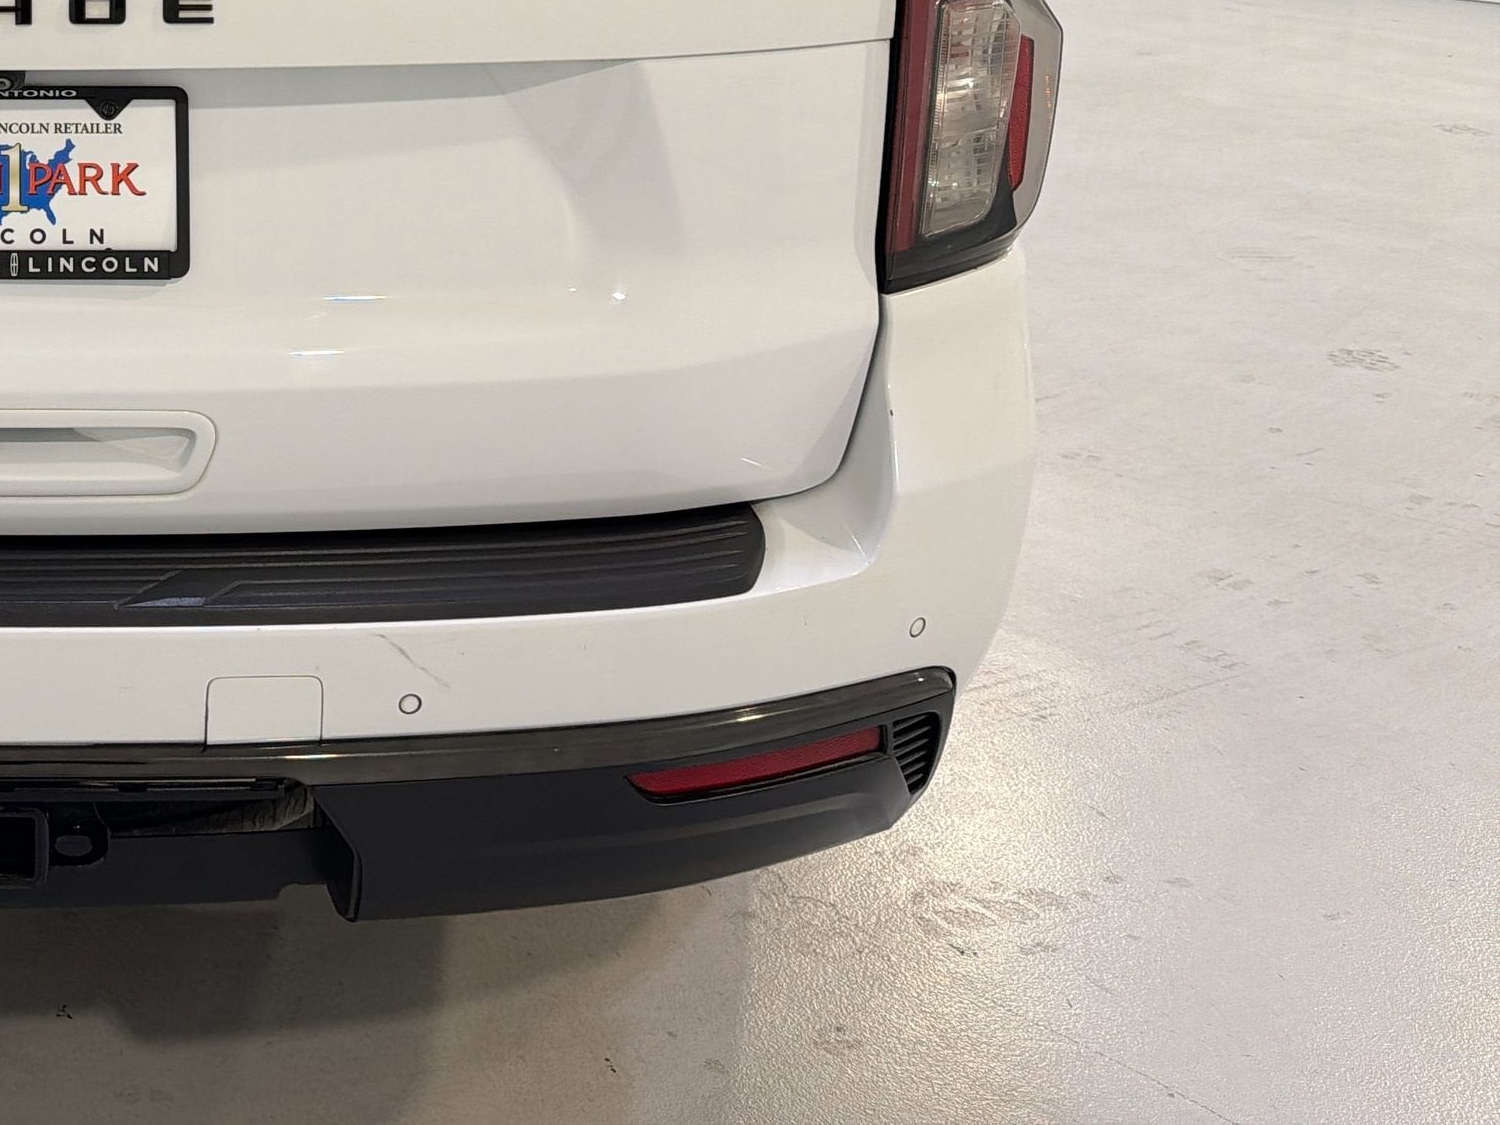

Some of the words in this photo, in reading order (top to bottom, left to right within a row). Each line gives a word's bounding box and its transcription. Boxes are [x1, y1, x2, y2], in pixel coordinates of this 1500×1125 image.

[53, 122, 123, 135] RETAILER
[27, 162, 147, 196] PARK
[28, 257, 159, 273] LINCOLN
